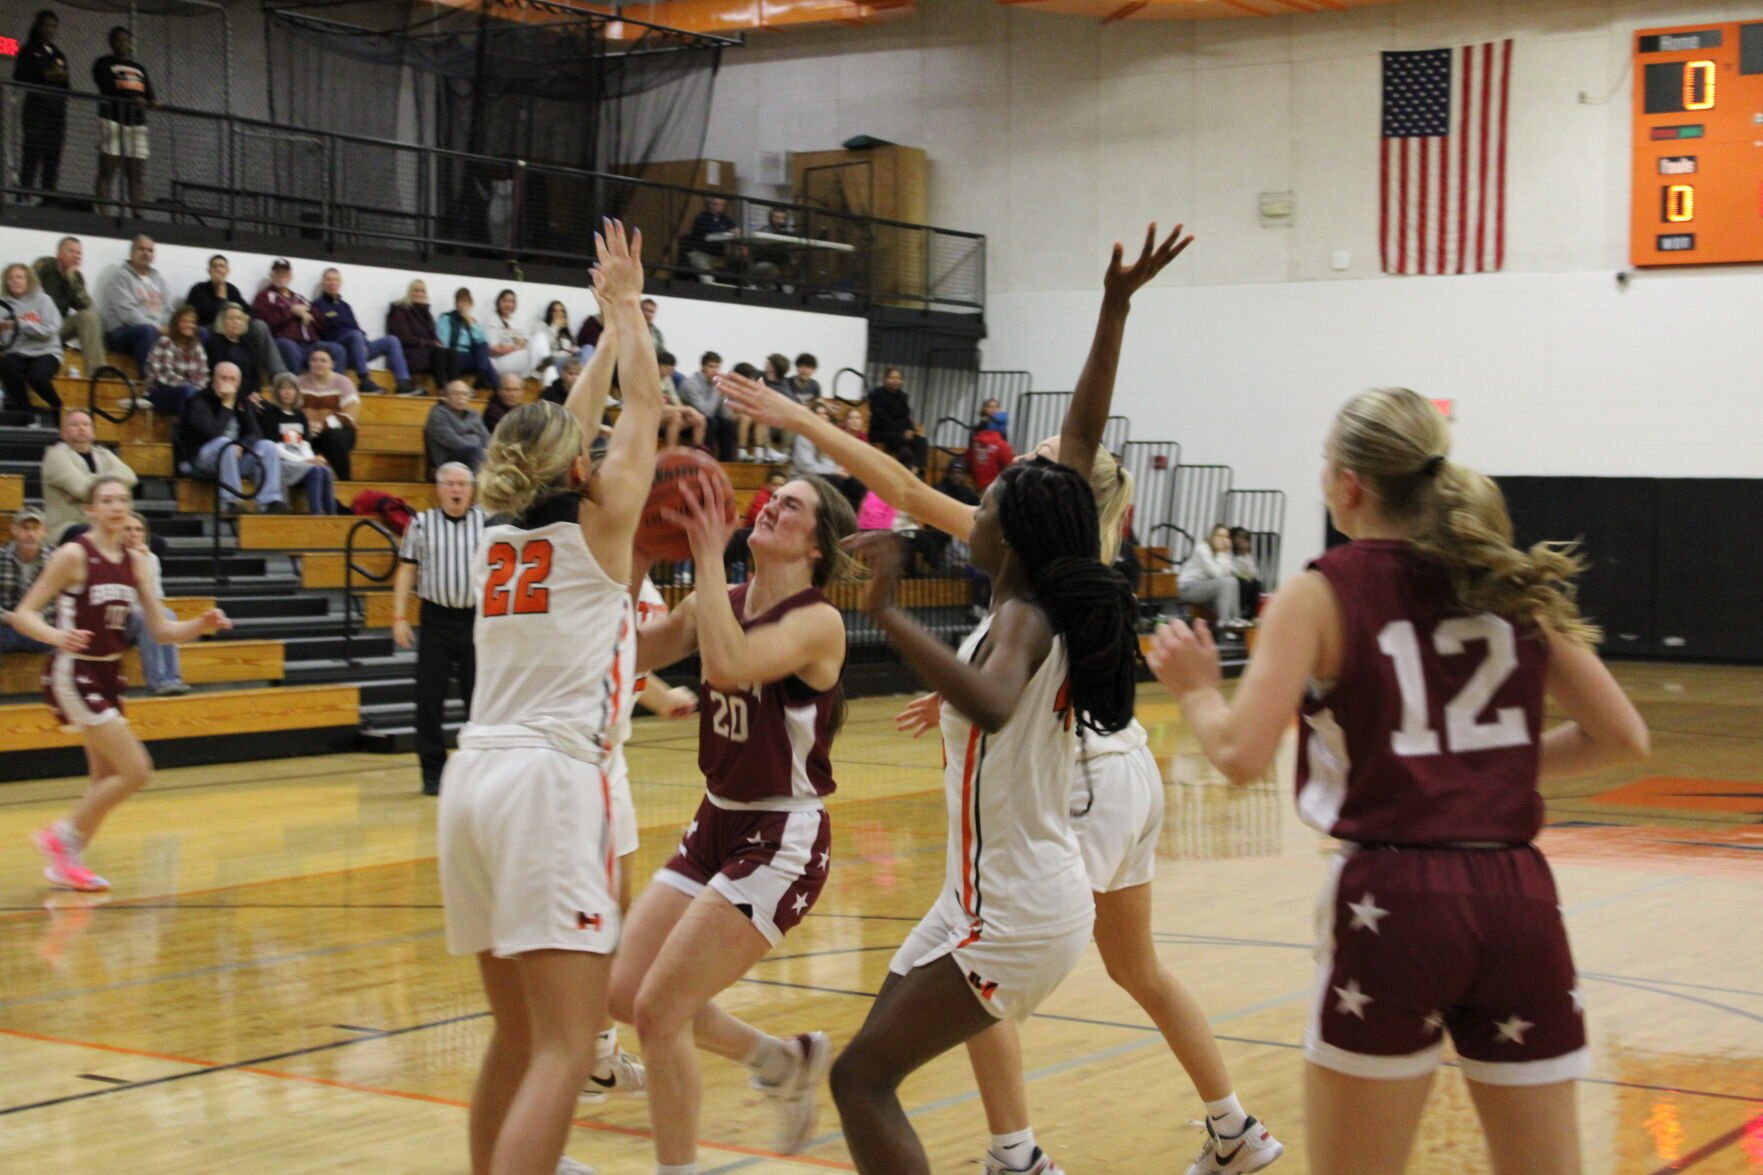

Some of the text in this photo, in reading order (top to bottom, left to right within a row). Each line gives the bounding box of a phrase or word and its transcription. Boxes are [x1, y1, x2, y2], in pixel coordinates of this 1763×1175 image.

[1683, 60, 1716, 110] 0
[1667, 185, 1695, 222] 0
[483, 539, 554, 617] 22
[1377, 612, 1532, 757] 12
[709, 691, 750, 743] 20
